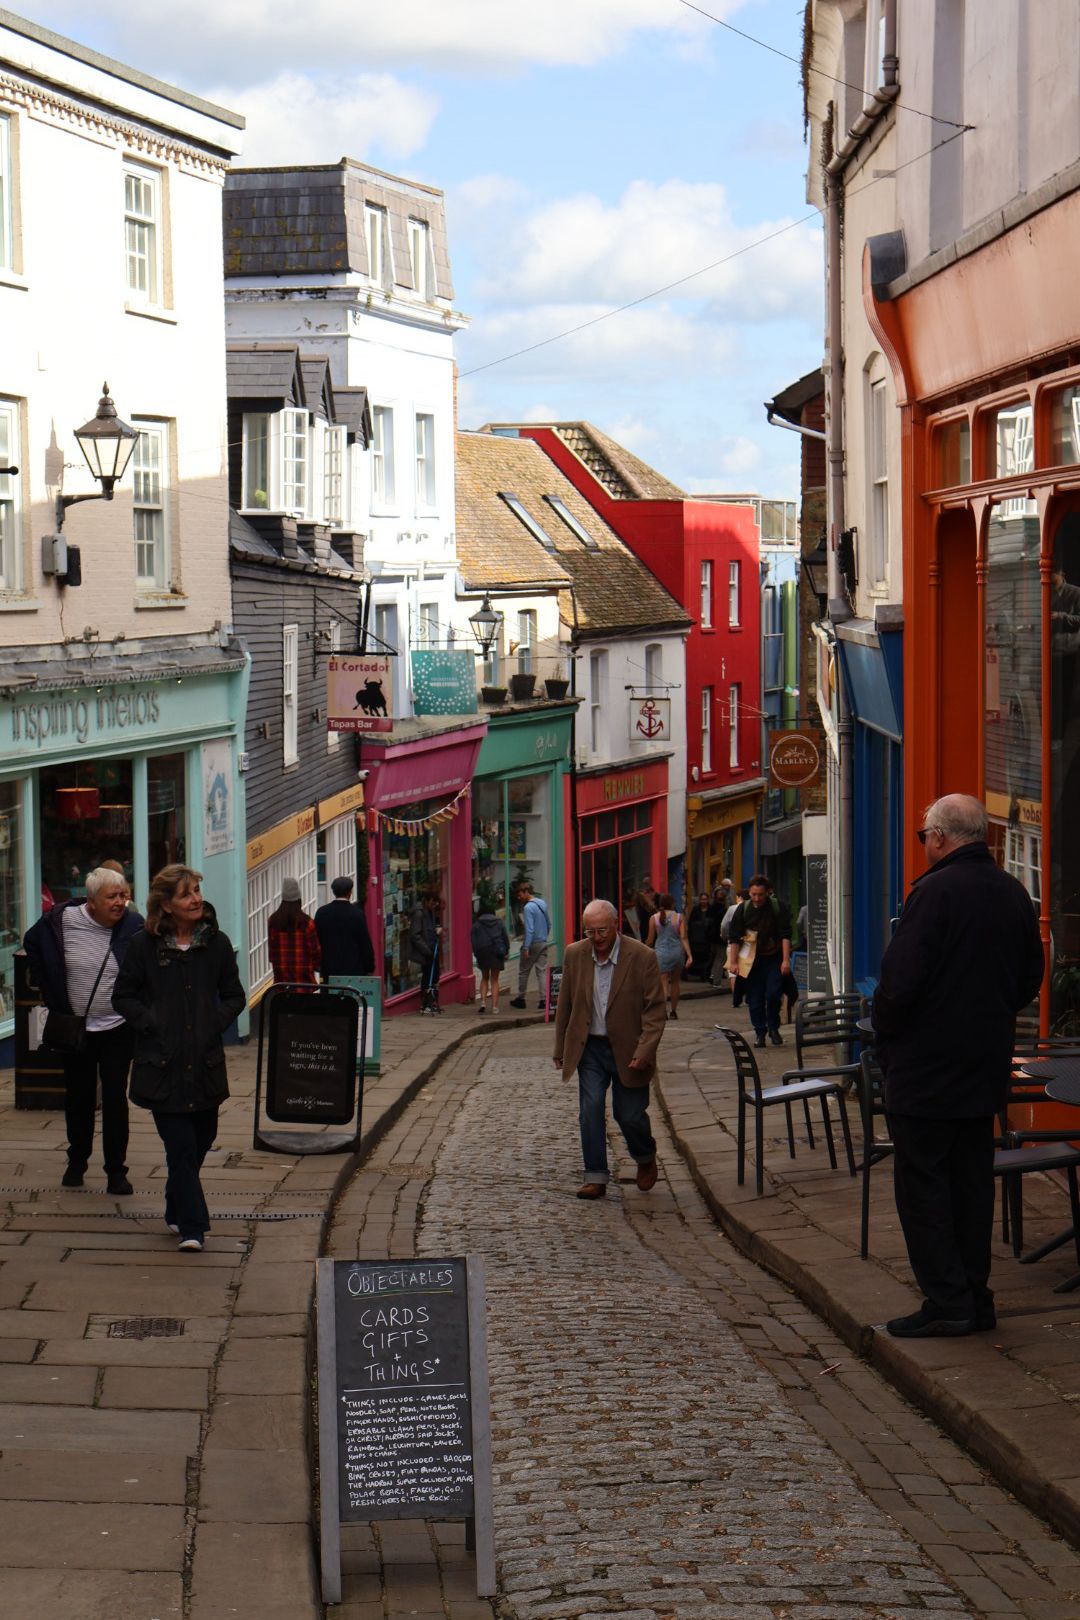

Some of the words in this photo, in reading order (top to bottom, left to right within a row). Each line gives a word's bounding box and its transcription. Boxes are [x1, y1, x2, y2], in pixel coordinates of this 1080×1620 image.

[329, 662, 338, 671] El
[341, 662, 389, 672] Cortador
[12, 699, 89, 748] inspiring
[95, 686, 160, 731] interiors
[329, 720, 355, 729] Tapas
[357, 720, 373, 728] Bar
[298, 1042, 320, 1050] you've
[321, 1043, 337, 1051] been
[290, 1051, 316, 1061] waiting
[348, 1269, 453, 1295] OBJECTABLES
[360, 1306, 430, 1328] CARDS
[362, 1329, 429, 1358] GIFTS
[394, 1353, 402, 1362] +
[379, 1396, 414, 1405] INCLUDE
[348, 1427, 386, 1436] ERASABLE
[389, 1425, 414, 1433] LLAMA
[357, 1435, 381, 1443] CHRIST
[376, 1460, 395, 1468] NOT
[397, 1456, 434, 1466] INCLUDED
[348, 1472, 366, 1482] BING
[365, 1479, 393, 1487] HADRON
[396, 1477, 417, 1486] SUPER
[349, 1490, 376, 1499] POLAR
[350, 1499, 376, 1508] FRESH
